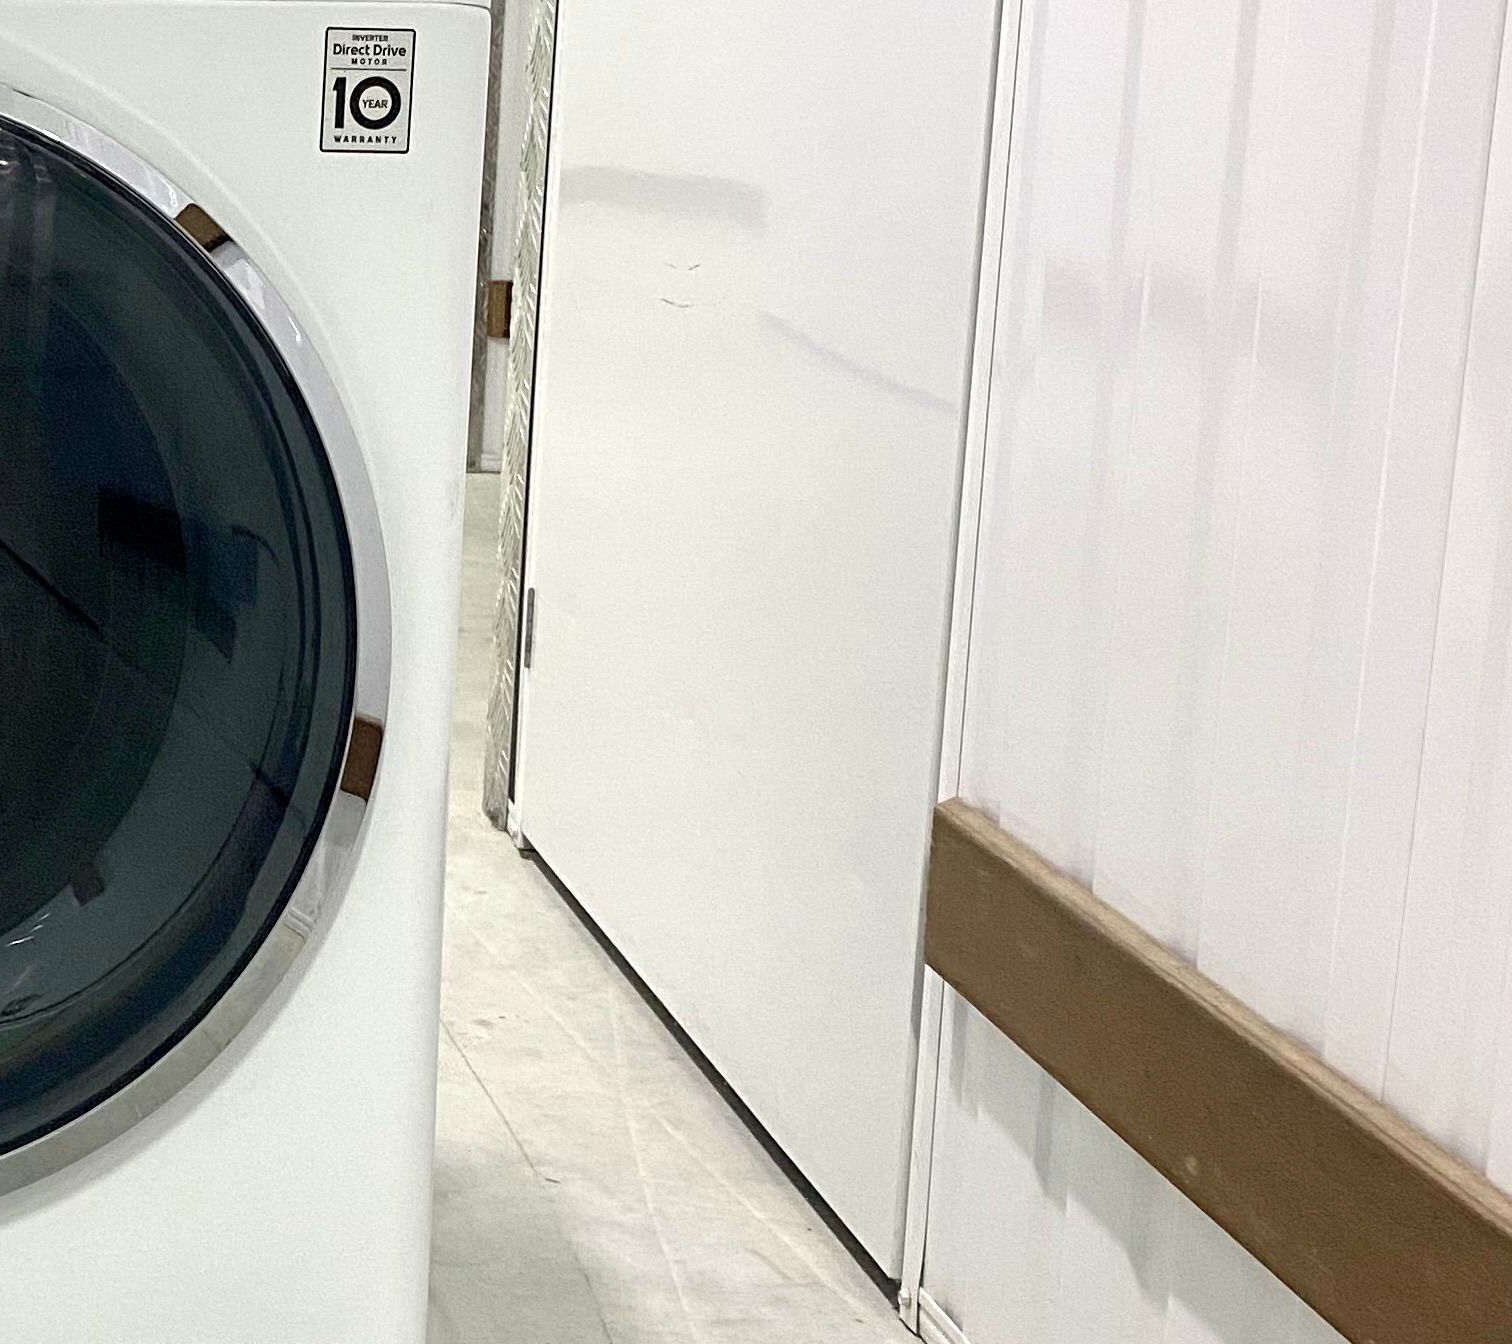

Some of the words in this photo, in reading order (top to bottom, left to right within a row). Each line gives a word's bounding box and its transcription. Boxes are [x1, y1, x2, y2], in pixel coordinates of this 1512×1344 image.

[352, 34, 389, 42] INVERTER
[333, 43, 370, 56] Direct
[373, 44, 407, 57] Drive
[351, 57, 388, 65] MOTOR
[332, 76, 402, 130] 10
[362, 99, 389, 109] YEAR
[333, 135, 398, 144] WARRANTY
